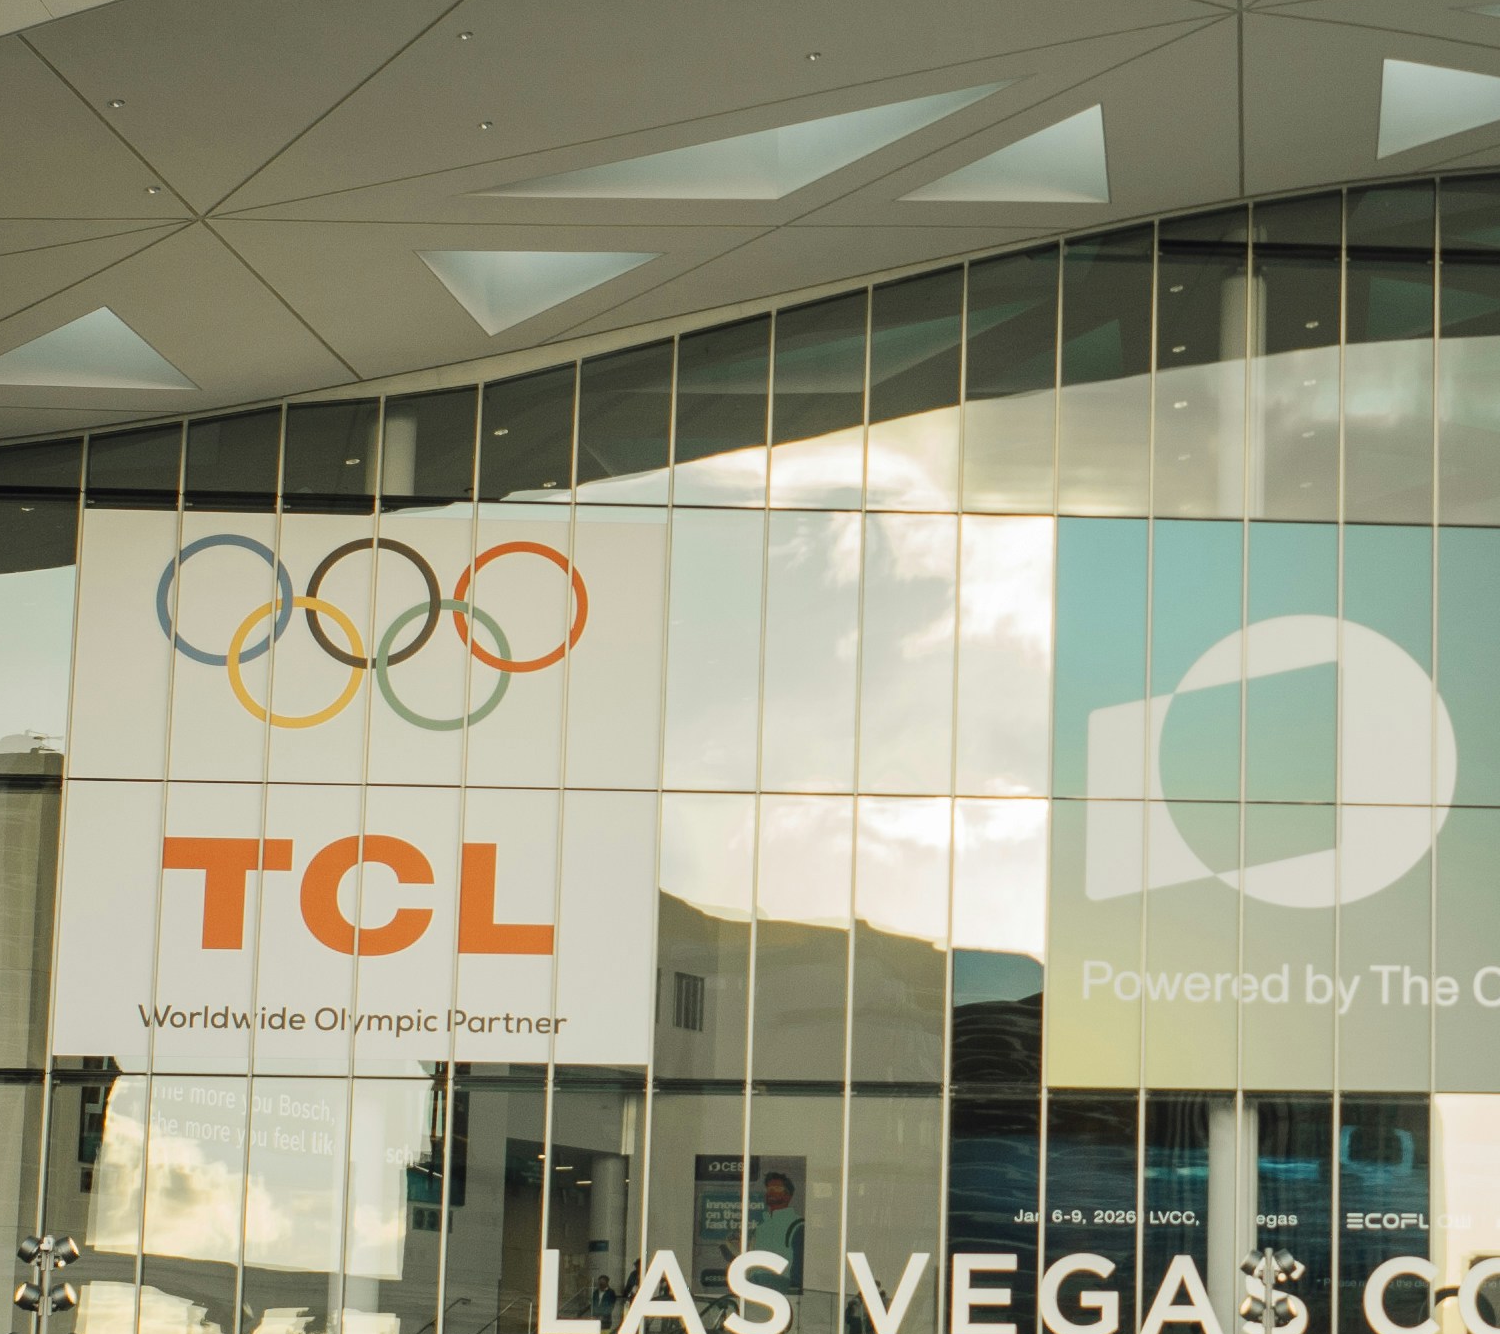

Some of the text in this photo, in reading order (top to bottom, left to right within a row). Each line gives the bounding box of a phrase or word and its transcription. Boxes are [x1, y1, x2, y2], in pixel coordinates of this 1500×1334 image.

[162, 834, 554, 955] TCL
[1080, 958, 1291, 1005] Powered
[1304, 960, 1360, 1018] by
[1370, 963, 1460, 1008] The
[138, 1004, 567, 1037] Worldwide Olympic Partner
[191, 1088, 237, 1109] more
[242, 1092, 273, 1116] you
[279, 1094, 337, 1126] Bosch,
[185, 1119, 231, 1143] more
[235, 1125, 268, 1149] you
[273, 1128, 307, 1154] feel
[705, 1210, 721, 1220] on
[706, 1199, 765, 1211] Innovaon
[1052, 1210, 1088, 1225] 6-9,
[1149, 1211, 1200, 1226] LVCC,
[1256, 1213, 1298, 1228] egas
[705, 1219, 759, 1230] fast trck
